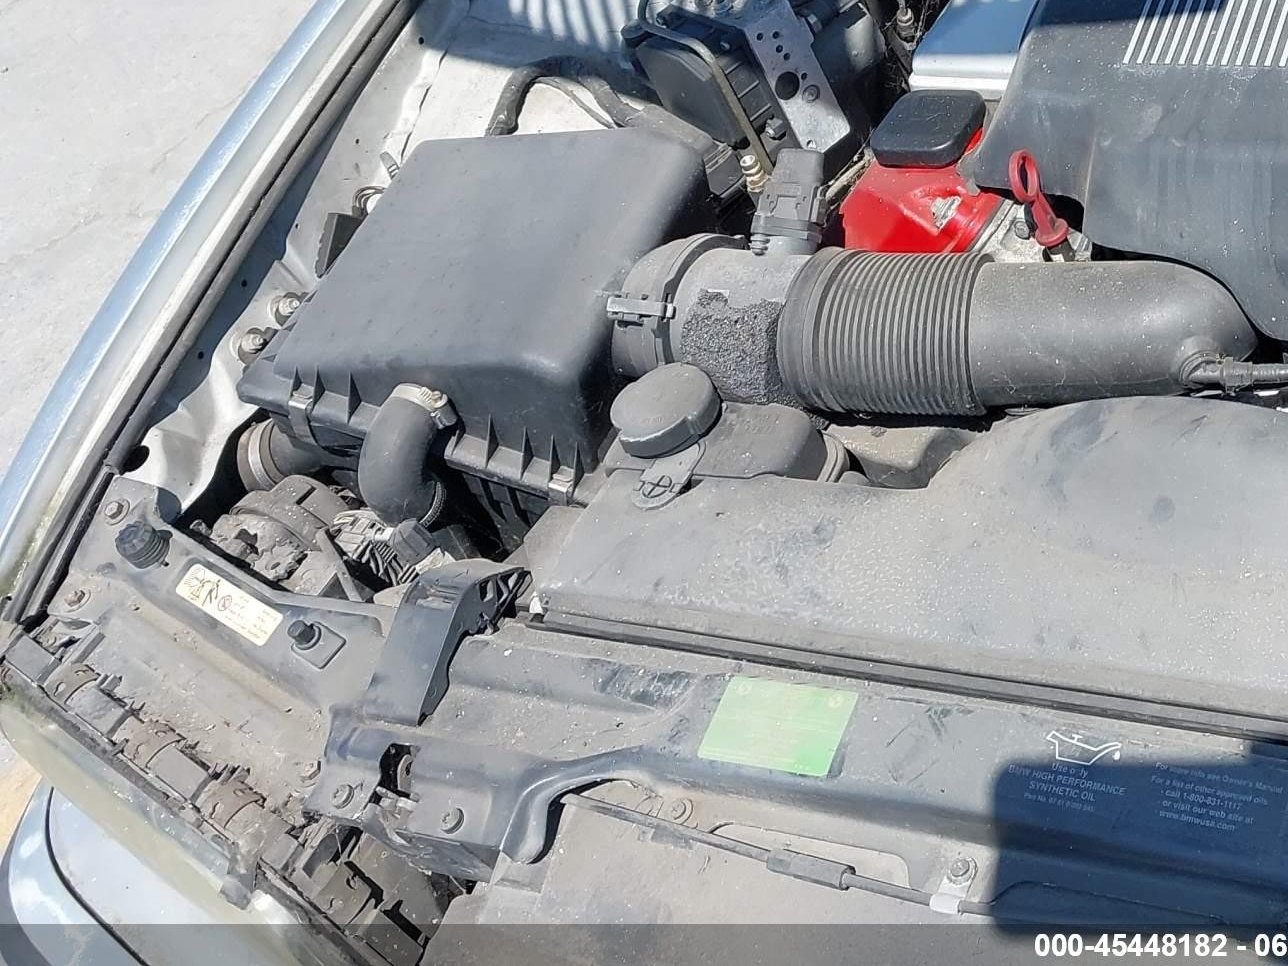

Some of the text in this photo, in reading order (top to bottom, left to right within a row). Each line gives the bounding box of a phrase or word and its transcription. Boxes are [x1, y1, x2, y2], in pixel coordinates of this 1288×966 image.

[1052, 762, 1088, 779] Use oly
[1156, 762, 1168, 771] For
[1008, 764, 1128, 796] BMW HIGH PERFORMANCE
[1151, 775, 1163, 784] For
[1029, 780, 1096, 802] SYNTHETIC OIL
[1162, 800, 1172, 808] or
[1174, 802, 1190, 811] visit
[1192, 806, 1206, 814] our
[1209, 808, 1226, 819] web
